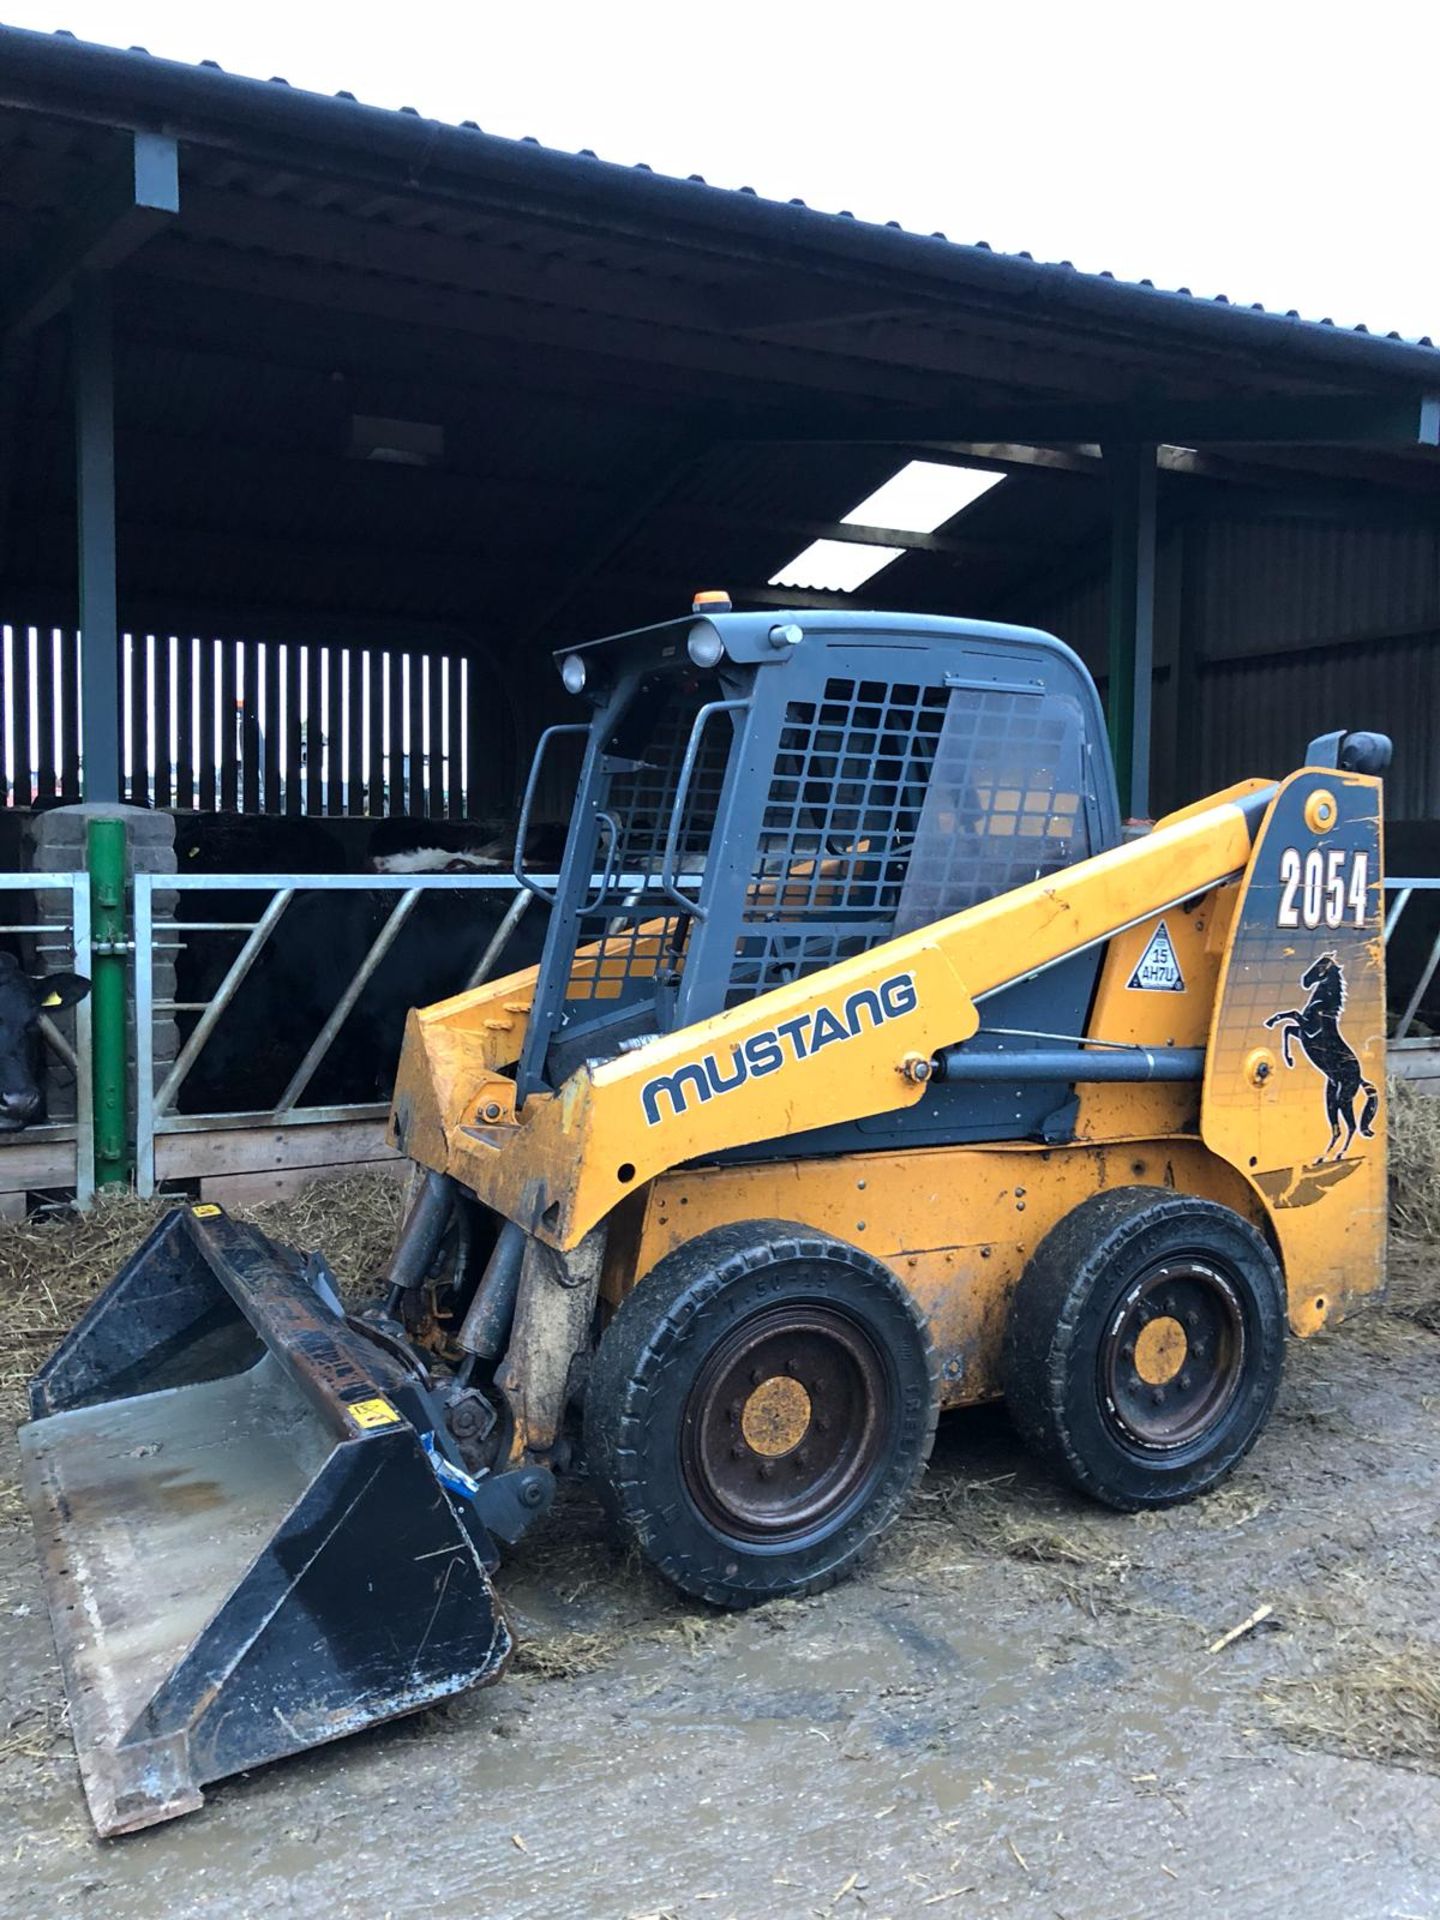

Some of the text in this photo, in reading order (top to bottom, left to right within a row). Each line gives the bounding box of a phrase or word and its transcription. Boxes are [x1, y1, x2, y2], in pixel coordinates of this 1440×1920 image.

[1277, 847, 1368, 929] 2054
[1142, 965, 1174, 982] AH7U
[1152, 948, 1168, 964] 15
[641, 973, 918, 1125] MUSTANG
